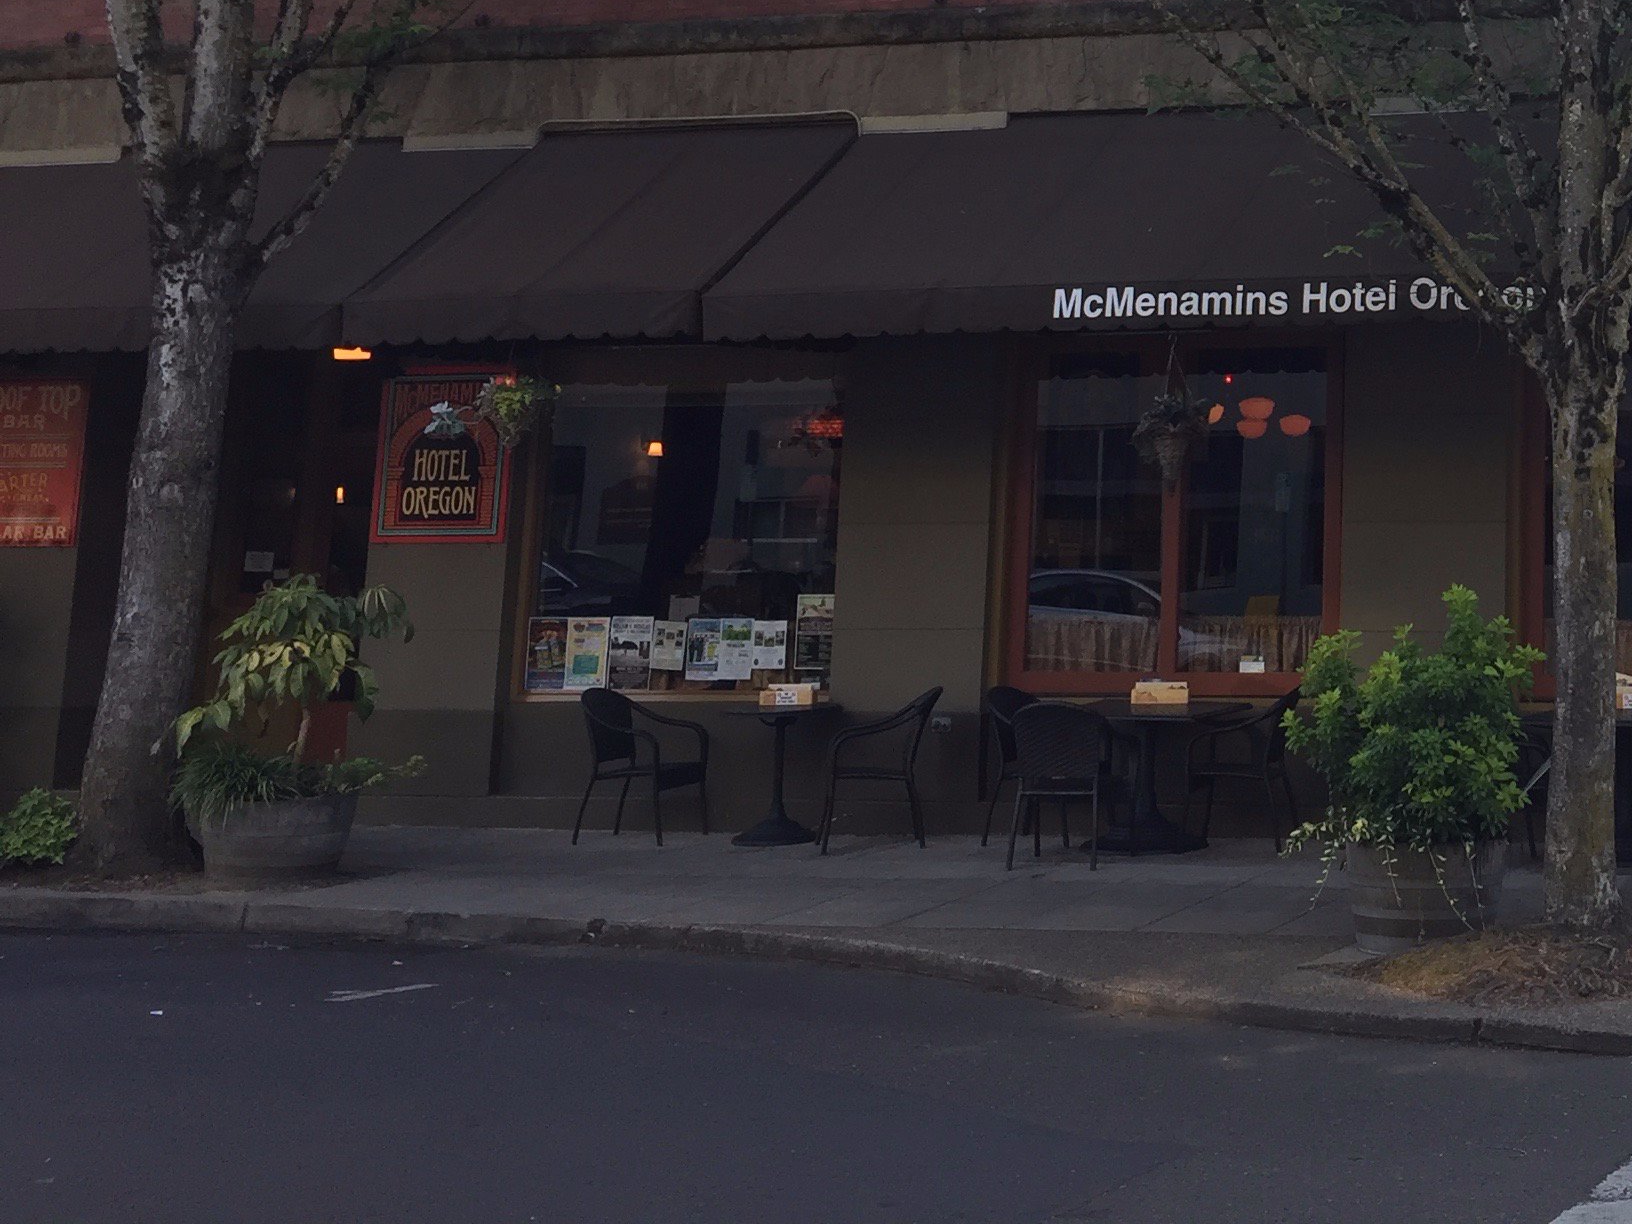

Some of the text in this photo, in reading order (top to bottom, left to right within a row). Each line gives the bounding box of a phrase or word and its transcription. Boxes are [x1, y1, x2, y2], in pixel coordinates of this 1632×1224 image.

[1052, 277, 1547, 318] McMenamins Hotel Oreon
[38, 385, 82, 421] TOP
[3, 414, 46, 431] BAR
[412, 449, 471, 482] HOTEL
[402, 486, 477, 519] OREGON
[34, 526, 67, 540] BAR
